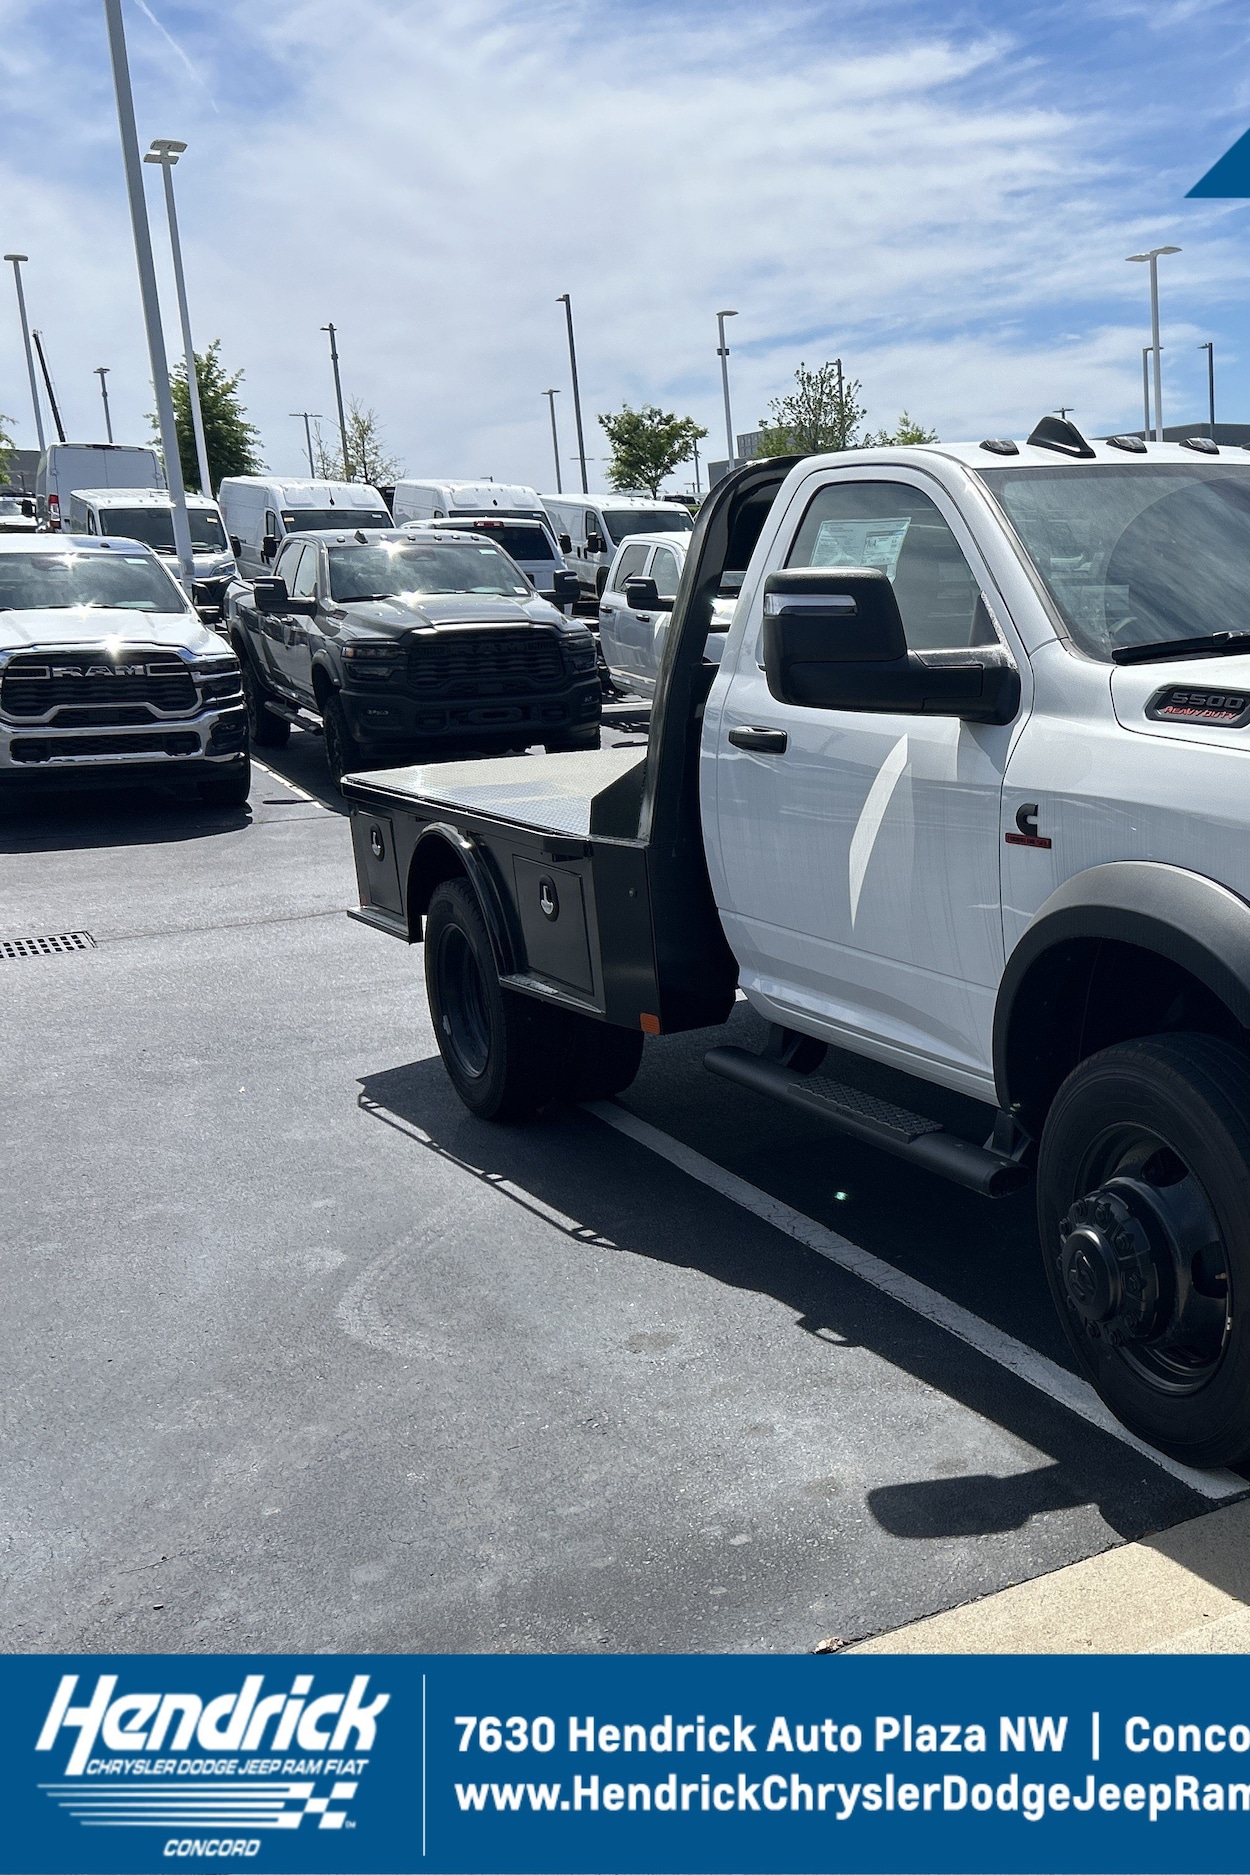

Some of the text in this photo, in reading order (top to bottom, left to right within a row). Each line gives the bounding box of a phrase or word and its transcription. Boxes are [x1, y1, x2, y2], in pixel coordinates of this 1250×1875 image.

[52, 665, 146, 678] RAM
[1170, 692, 1245, 709] 5500
[1164, 705, 1238, 720] HEAVY DUTY
